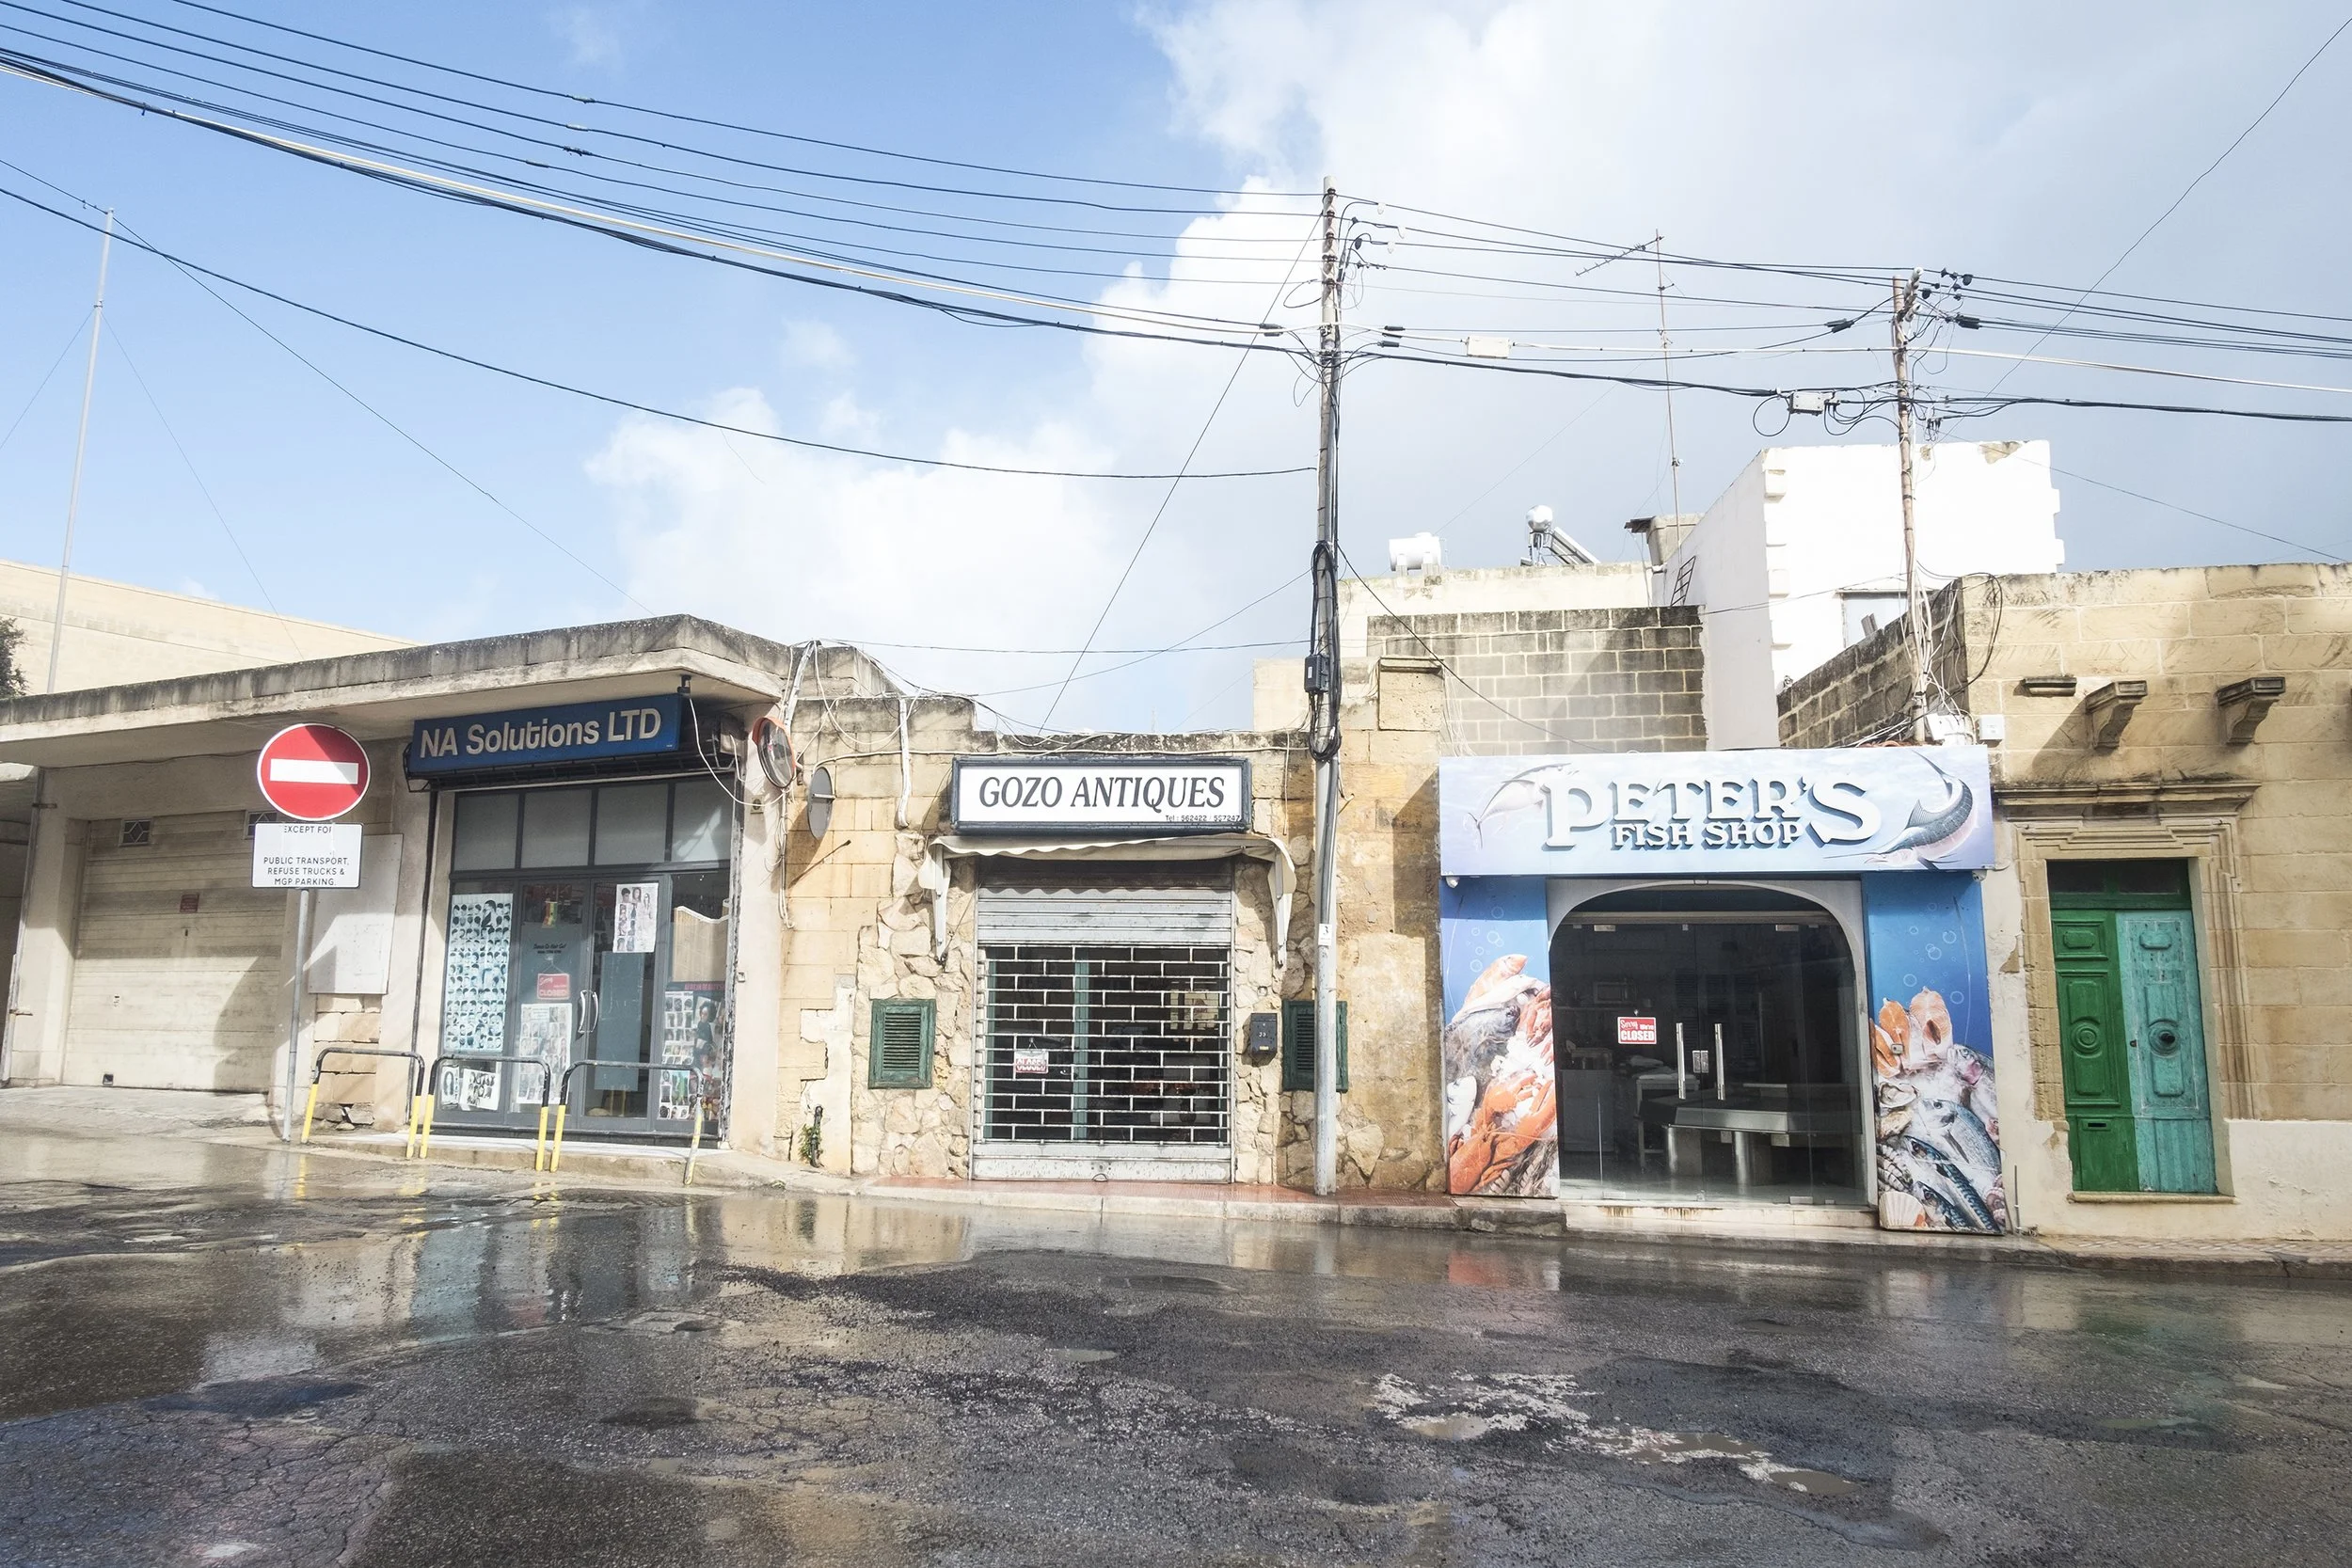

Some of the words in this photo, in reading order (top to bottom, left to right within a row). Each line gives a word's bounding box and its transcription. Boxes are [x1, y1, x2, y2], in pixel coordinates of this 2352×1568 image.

[420, 727, 459, 758] NA
[466, 718, 600, 755] Solutions
[607, 707, 662, 742] LTD
[978, 776, 1063, 808] GOZO
[1070, 776, 1225, 814] ANTIQUES
[1541, 773, 1883, 851] PETER'S
[1612, 821, 1694, 849] FISH
[1703, 821, 1804, 849] SHOP
[263, 856, 294, 865] PUBLIC
[296, 857, 350, 866] TRANSPORT,
[267, 867, 300, 876] REFUSE
[302, 867, 337, 876] TRUCKS
[339, 867, 345, 876] &
[274, 878, 294, 886] MGP
[294, 878, 337, 886] PARKING.
[1620, 1019, 1639, 1031] Sorry
[1620, 1030, 1655, 1041] CLOSED
